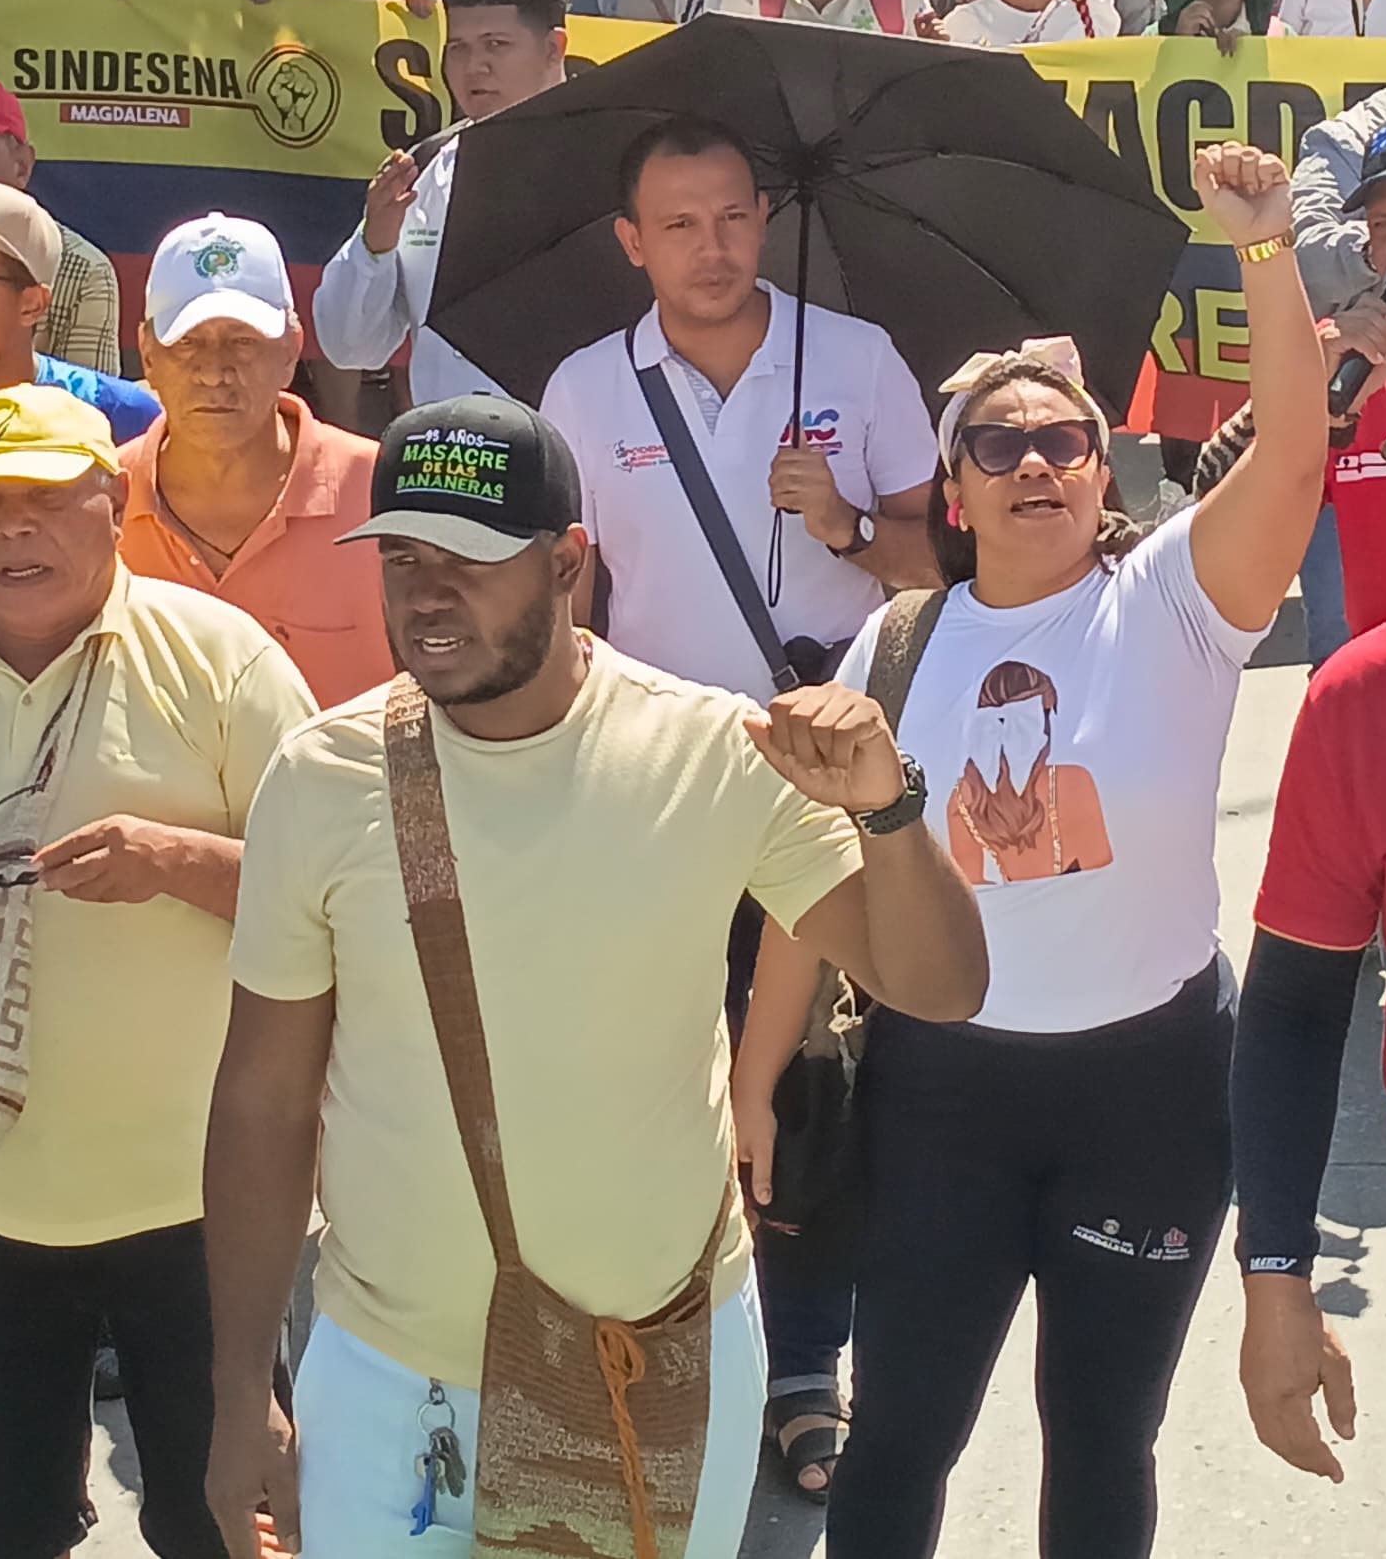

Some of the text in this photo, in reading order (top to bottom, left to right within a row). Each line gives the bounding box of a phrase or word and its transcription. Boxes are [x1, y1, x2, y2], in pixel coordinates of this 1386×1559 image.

[14, 48, 243, 99] SINDESENA
[70, 105, 182, 125] MAGDALENA
[446, 427, 486, 447] AÑOS
[403, 443, 509, 471] MASACRE
[422, 461, 477, 478] DE LAS
[396, 473, 505, 499] BANANERAS
